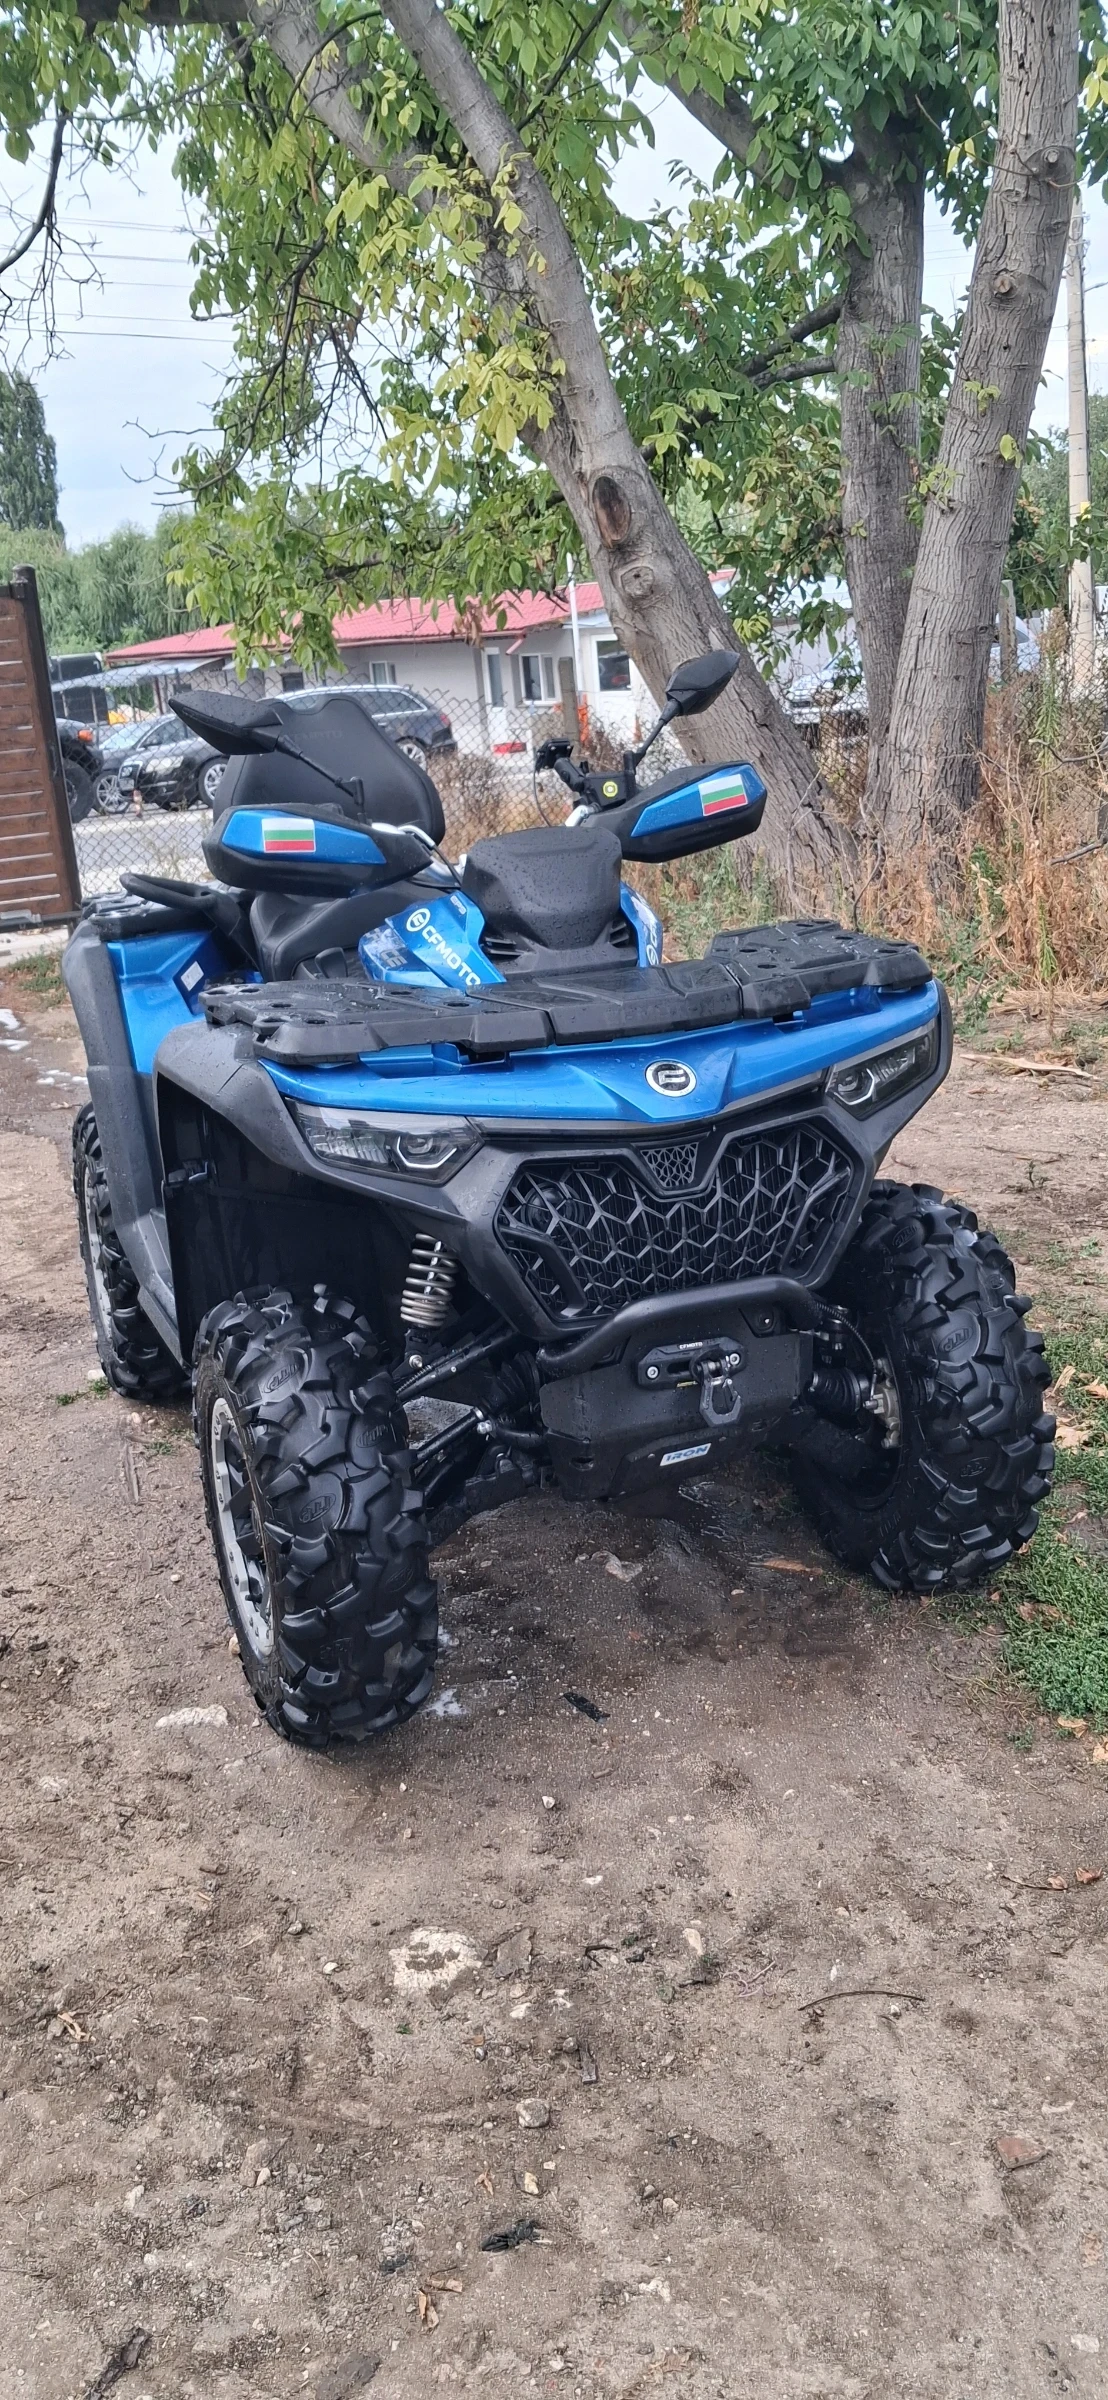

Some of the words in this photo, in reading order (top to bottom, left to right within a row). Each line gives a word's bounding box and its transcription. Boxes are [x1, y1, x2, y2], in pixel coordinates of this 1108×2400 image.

[422, 925, 481, 986] CFMOTO
[944, 1328, 969, 1351] ITP
[665, 1446, 708, 1462] IRON
